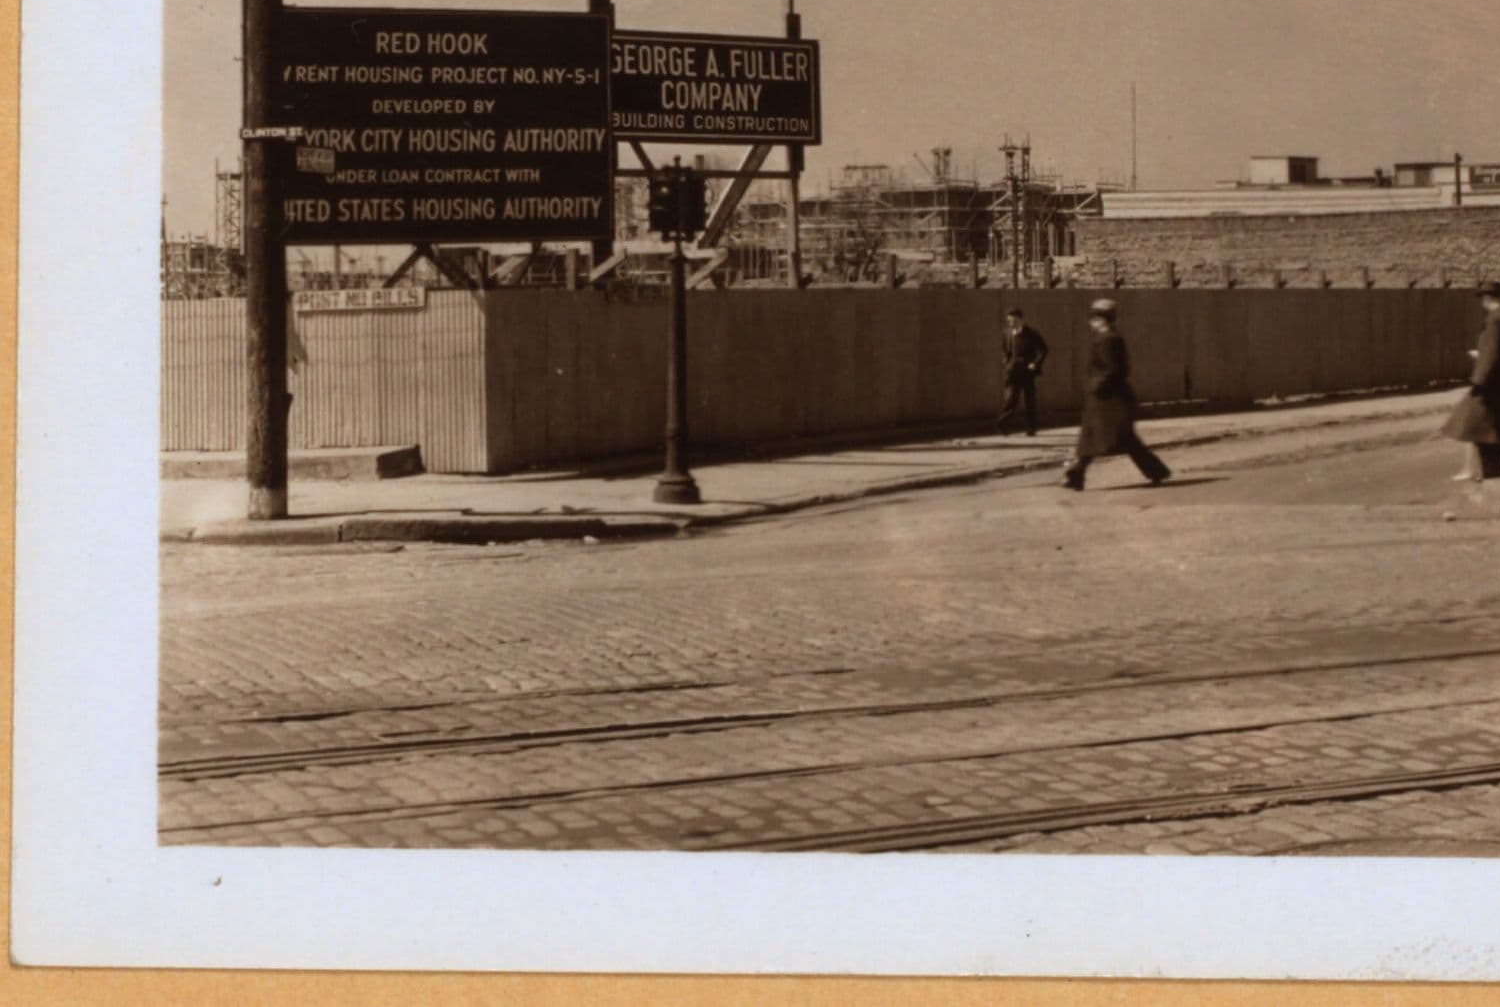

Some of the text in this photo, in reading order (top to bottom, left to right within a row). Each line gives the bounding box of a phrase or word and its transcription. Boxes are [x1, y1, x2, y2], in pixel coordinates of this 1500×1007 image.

[375, 33, 488, 55] RED HOOK
[611, 43, 808, 83] GEORGE A. FULLER
[295, 65, 339, 83] RENT
[345, 65, 423, 84] HOUSING
[431, 66, 507, 86] PROJECT
[513, 67, 540, 86] NO.
[372, 98, 495, 115] DEVELOPED BY
[660, 82, 762, 112] COMPANY
[613, 112, 808, 132] BUILDING CONSTRUCTION
[241, 128, 285, 138] CLINTON
[302, 128, 605, 153] YORK CITY HOUSING AUTHORITY
[382, 168, 420, 183] LOAN
[425, 168, 500, 184] CONTRACT
[506, 168, 540, 183] WITH
[285, 196, 601, 221] ITED STATES HOUSING AUTHORITY
[298, 292, 341, 308] POST
[371, 289, 419, 306] BILLS
